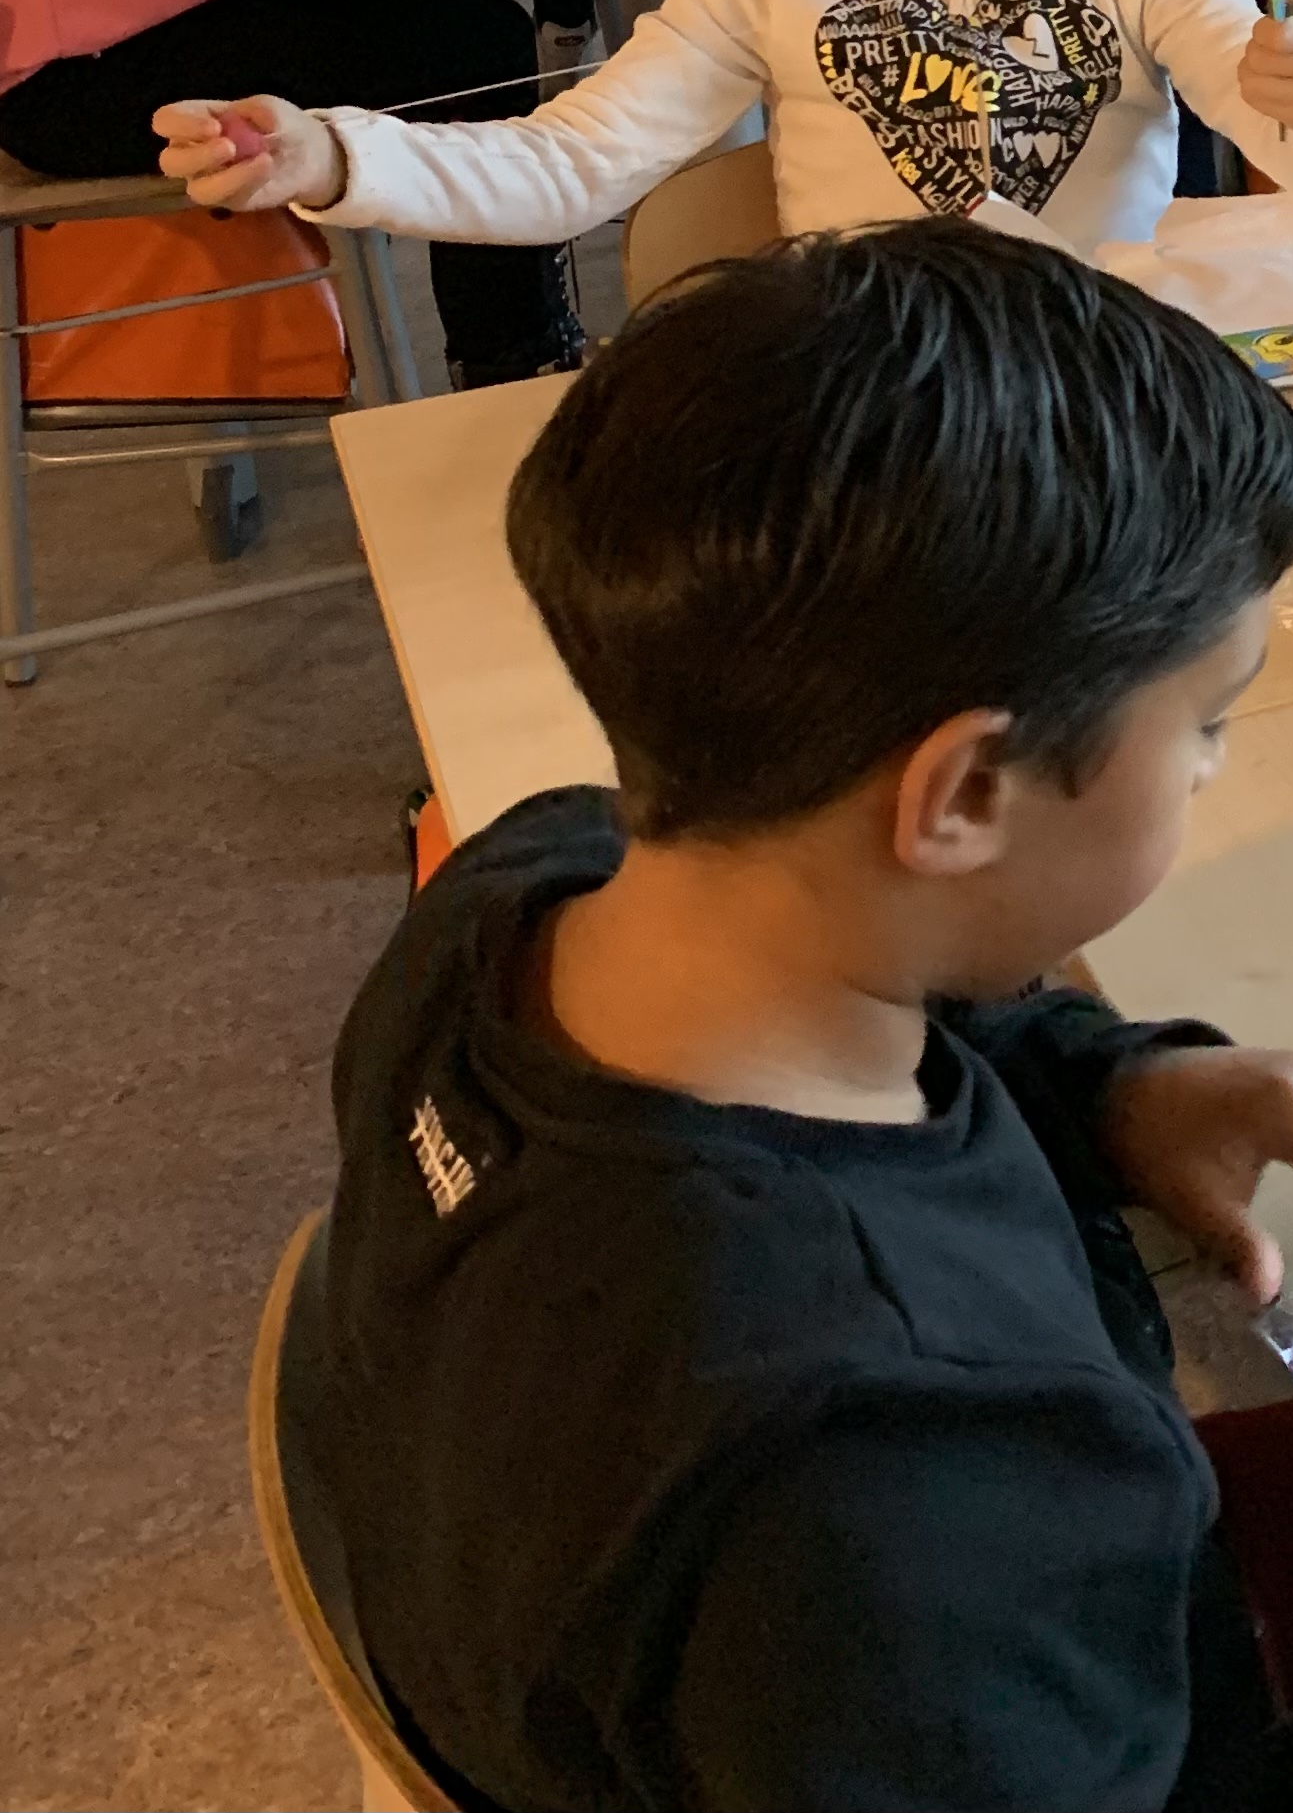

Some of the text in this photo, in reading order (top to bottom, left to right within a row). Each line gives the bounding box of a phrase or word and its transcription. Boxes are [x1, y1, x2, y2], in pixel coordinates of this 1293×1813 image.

[845, 31, 945, 70] PRETTY
[1047, 6, 1088, 65] PRETTY
[901, 116, 1003, 151] FASHION
